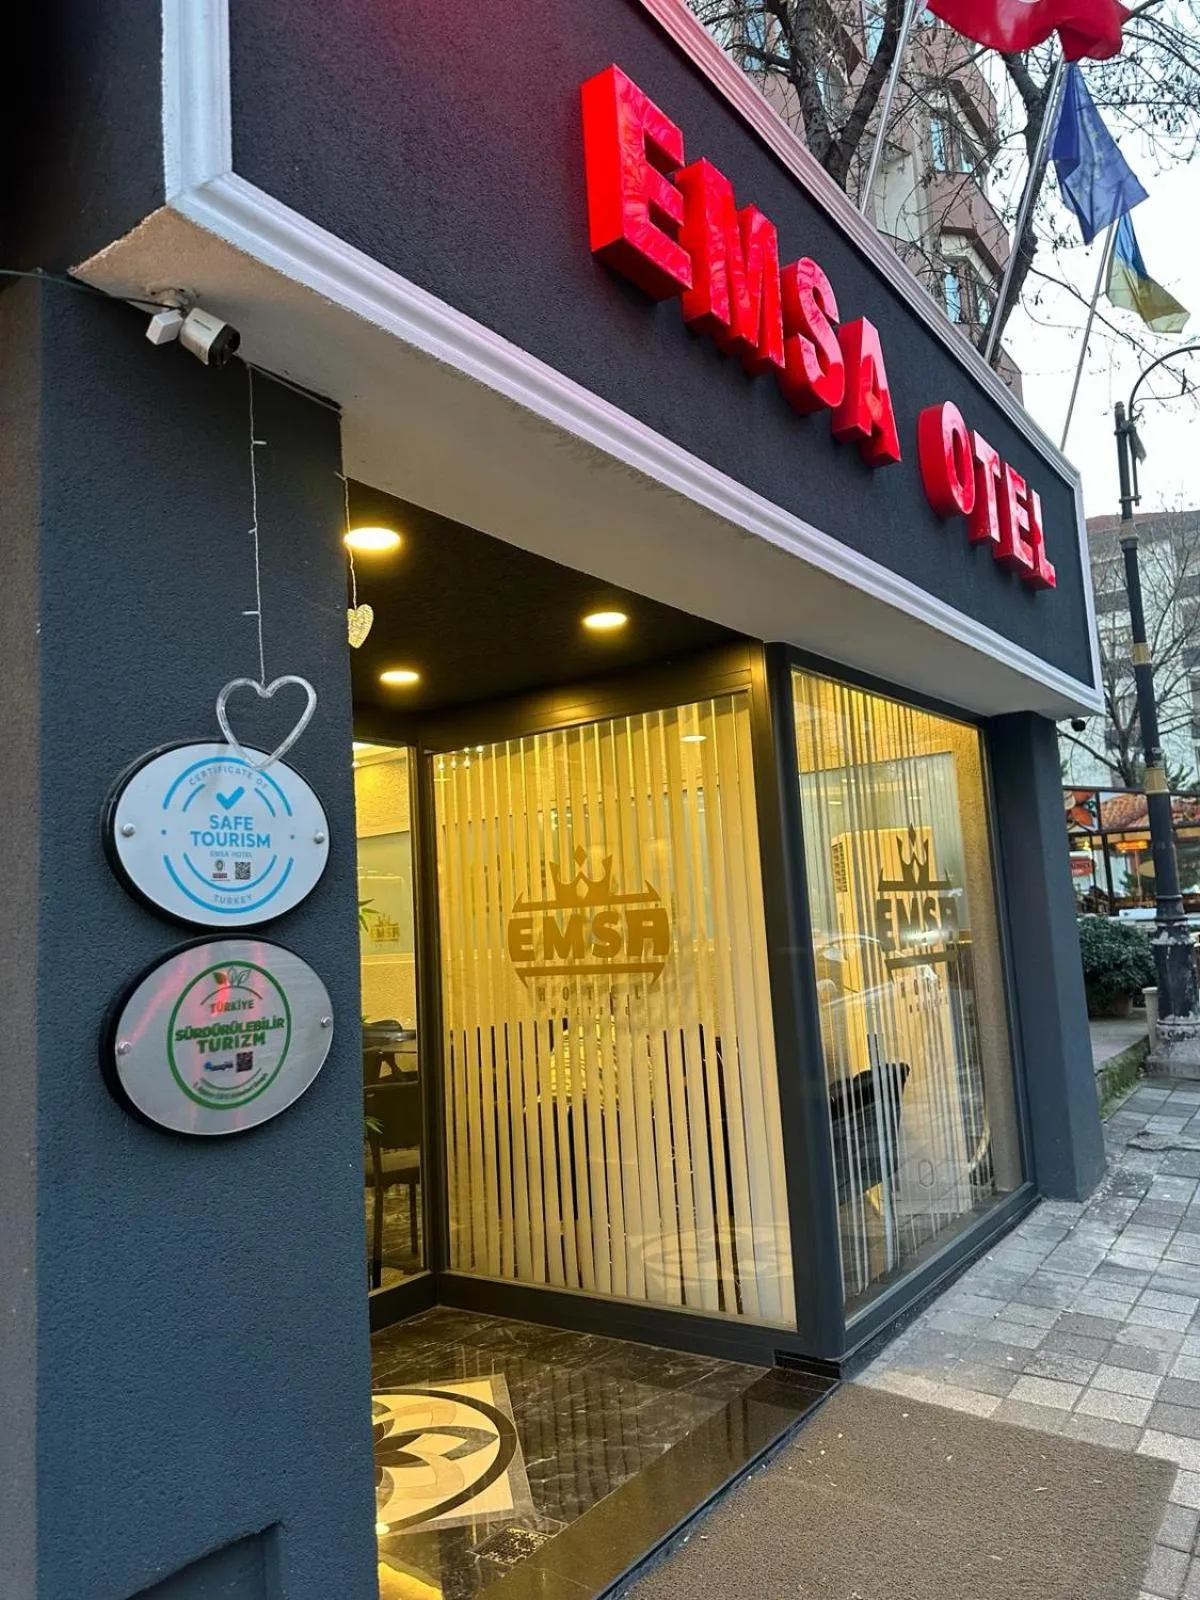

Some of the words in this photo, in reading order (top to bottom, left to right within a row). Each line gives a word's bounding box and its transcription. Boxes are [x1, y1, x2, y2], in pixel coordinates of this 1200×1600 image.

[581, 64, 902, 468] EMSA
[917, 400, 1056, 590] OTEL
[189, 765, 253, 786] CERTIFICATE
[255, 778, 268, 789] OF
[209, 814, 254, 831] SAFE
[190, 830, 271, 848] TOURISM
[213, 894, 253, 904] TURKEY
[507, 908, 669, 962] EMSA
[876, 896, 960, 953] EMSA
